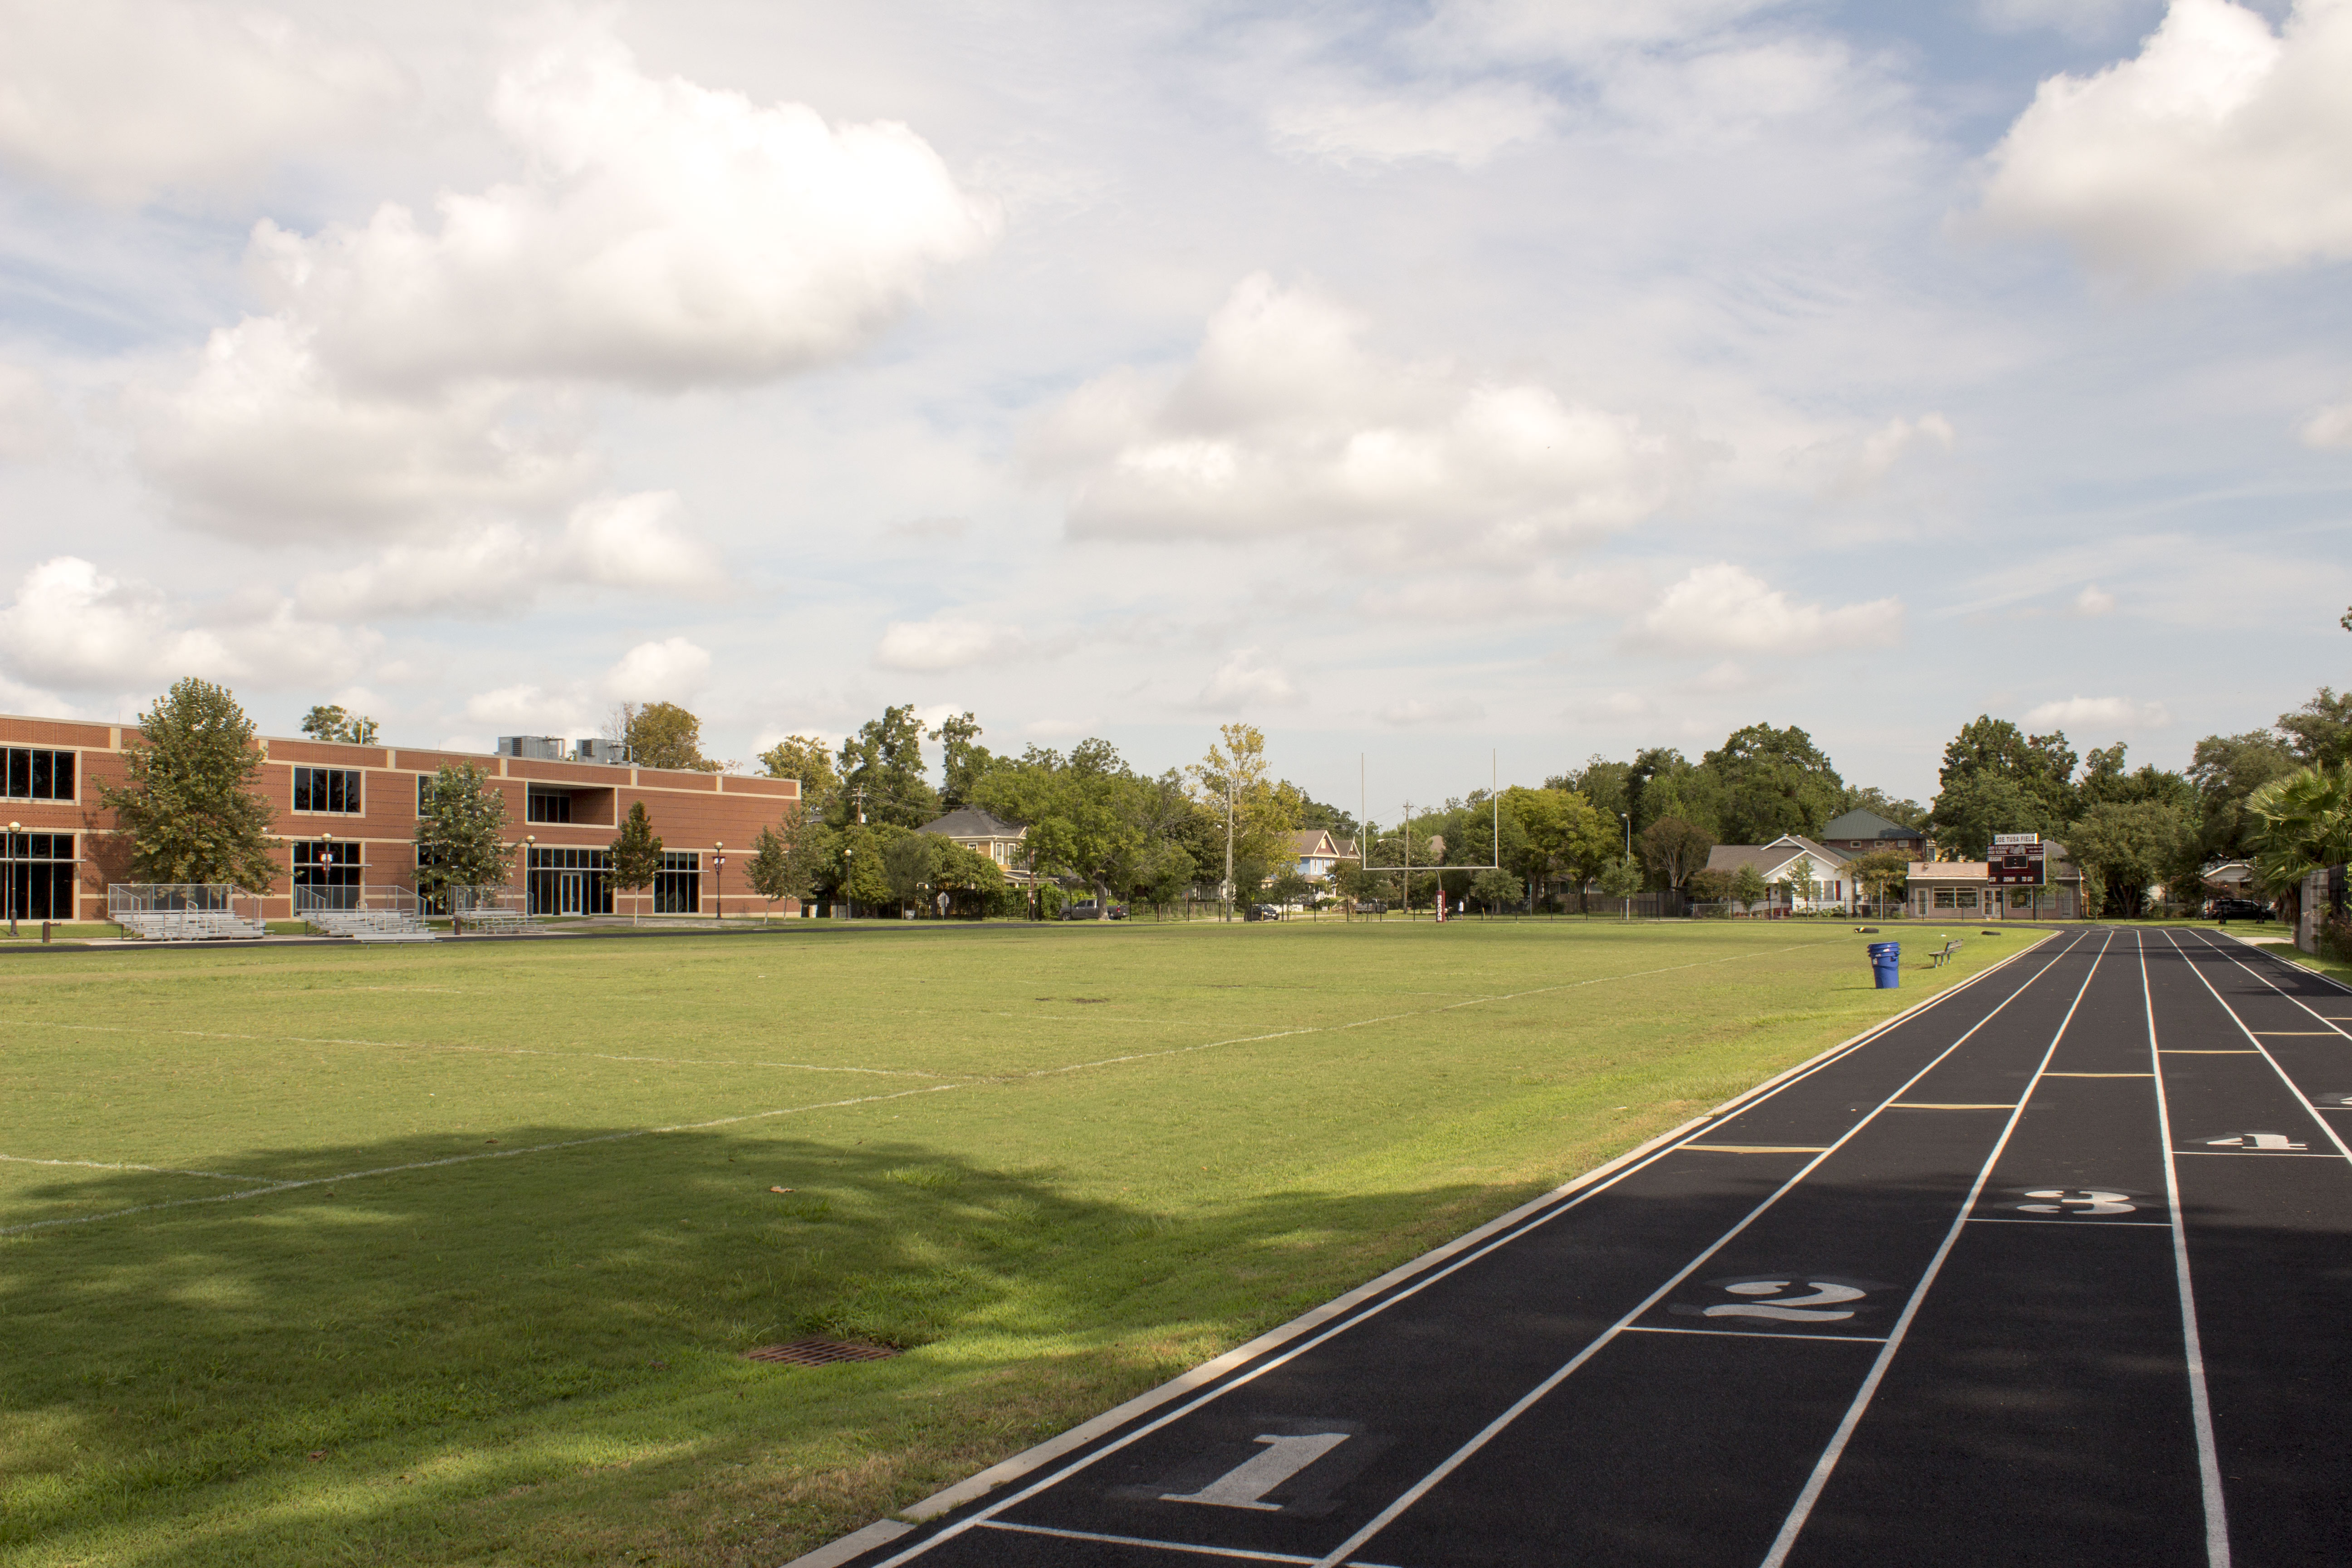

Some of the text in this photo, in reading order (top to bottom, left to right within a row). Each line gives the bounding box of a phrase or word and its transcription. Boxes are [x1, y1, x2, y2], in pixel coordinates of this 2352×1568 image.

[2206, 1133, 2308, 1150] 4
[2016, 1190, 2136, 1214] 3
[1703, 1281, 1866, 1322] 2
[1160, 1432, 1350, 1511] 1
